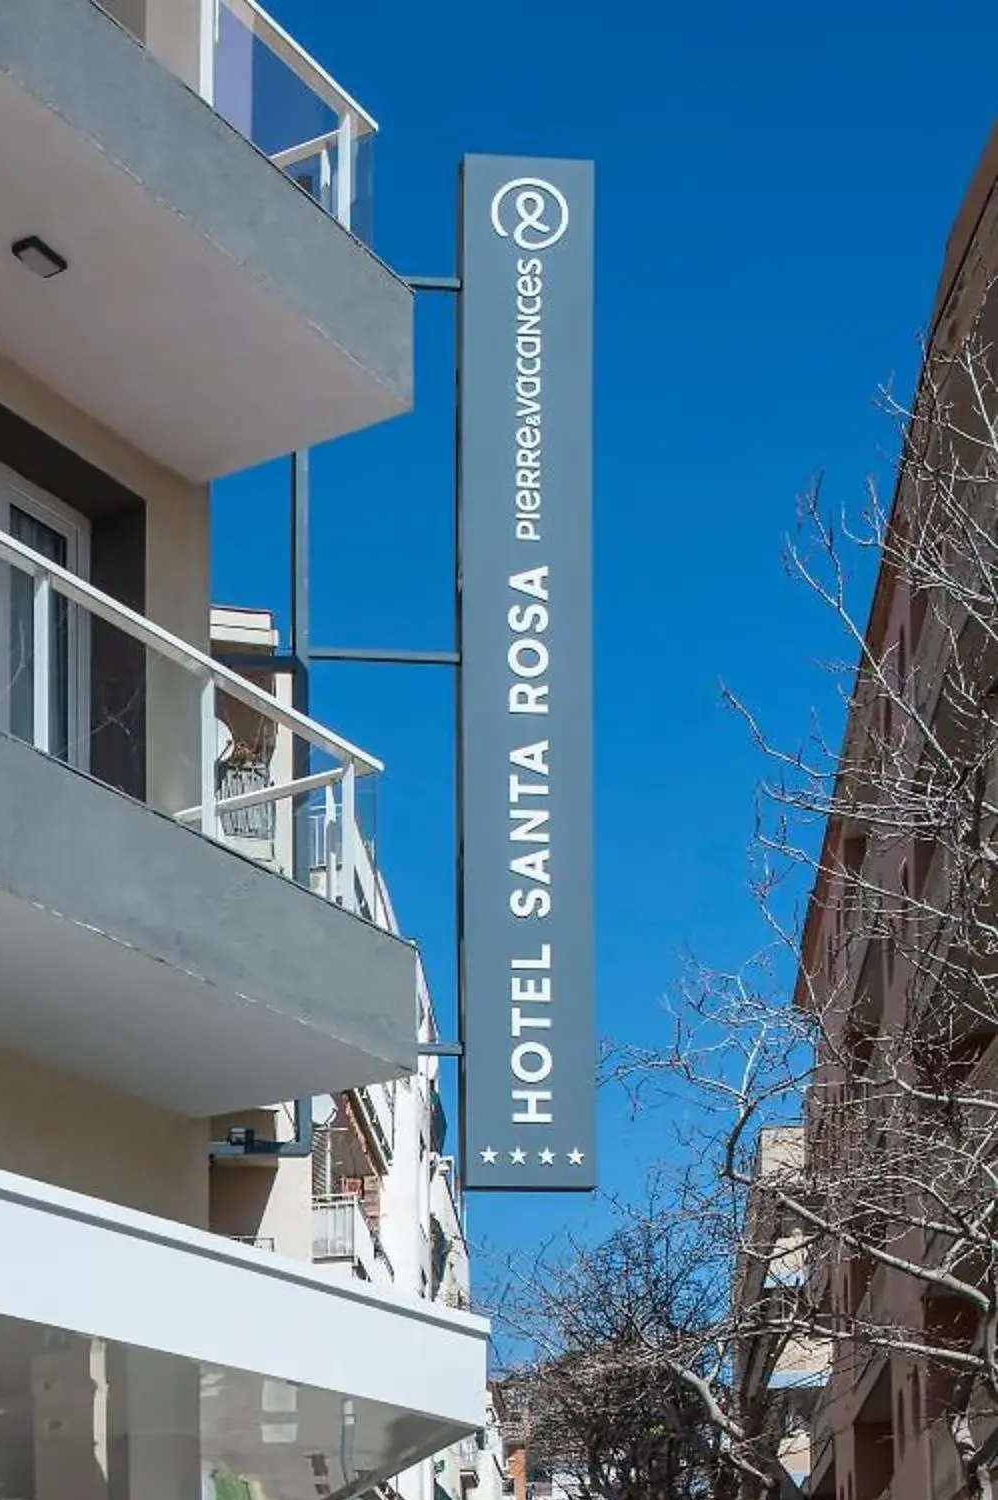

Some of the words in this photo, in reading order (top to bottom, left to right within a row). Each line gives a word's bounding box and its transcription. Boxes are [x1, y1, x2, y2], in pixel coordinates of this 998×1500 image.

[506, 564, 551, 715] ROSA
[508, 739, 552, 919] SANTA
[510, 943, 554, 1125] HOTEL
